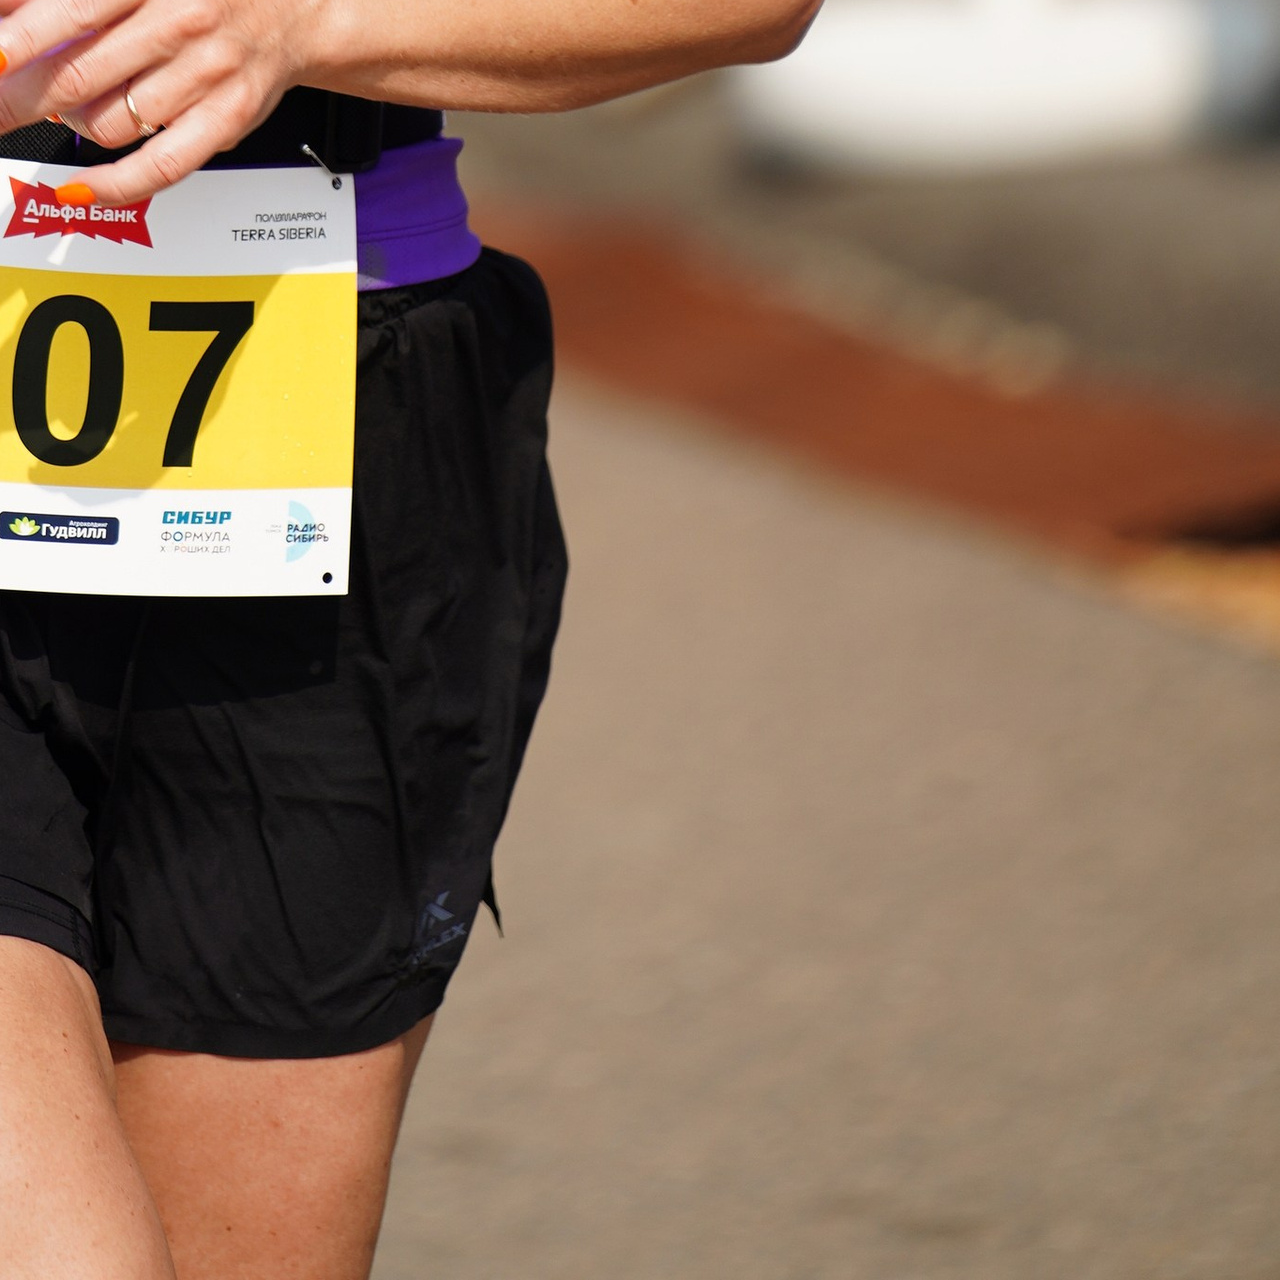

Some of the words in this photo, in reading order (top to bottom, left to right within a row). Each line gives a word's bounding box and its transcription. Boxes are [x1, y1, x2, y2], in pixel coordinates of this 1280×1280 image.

[23, 199, 86, 223] Альфа
[89, 204, 138, 223] Банк
[232, 228, 276, 241] TERRA
[279, 227, 327, 240] SIBERIA
[162, 511, 232, 524] СИБУР
[41, 523, 107, 539] Гудвилл
[287, 523, 326, 533] РАДИО
[160, 531, 231, 542] ФОРМУЛА
[286, 534, 329, 543] СИБИРЬ
[160, 545, 210, 554] ХРОШИХ
[212, 545, 231, 554] ДЕЛ
